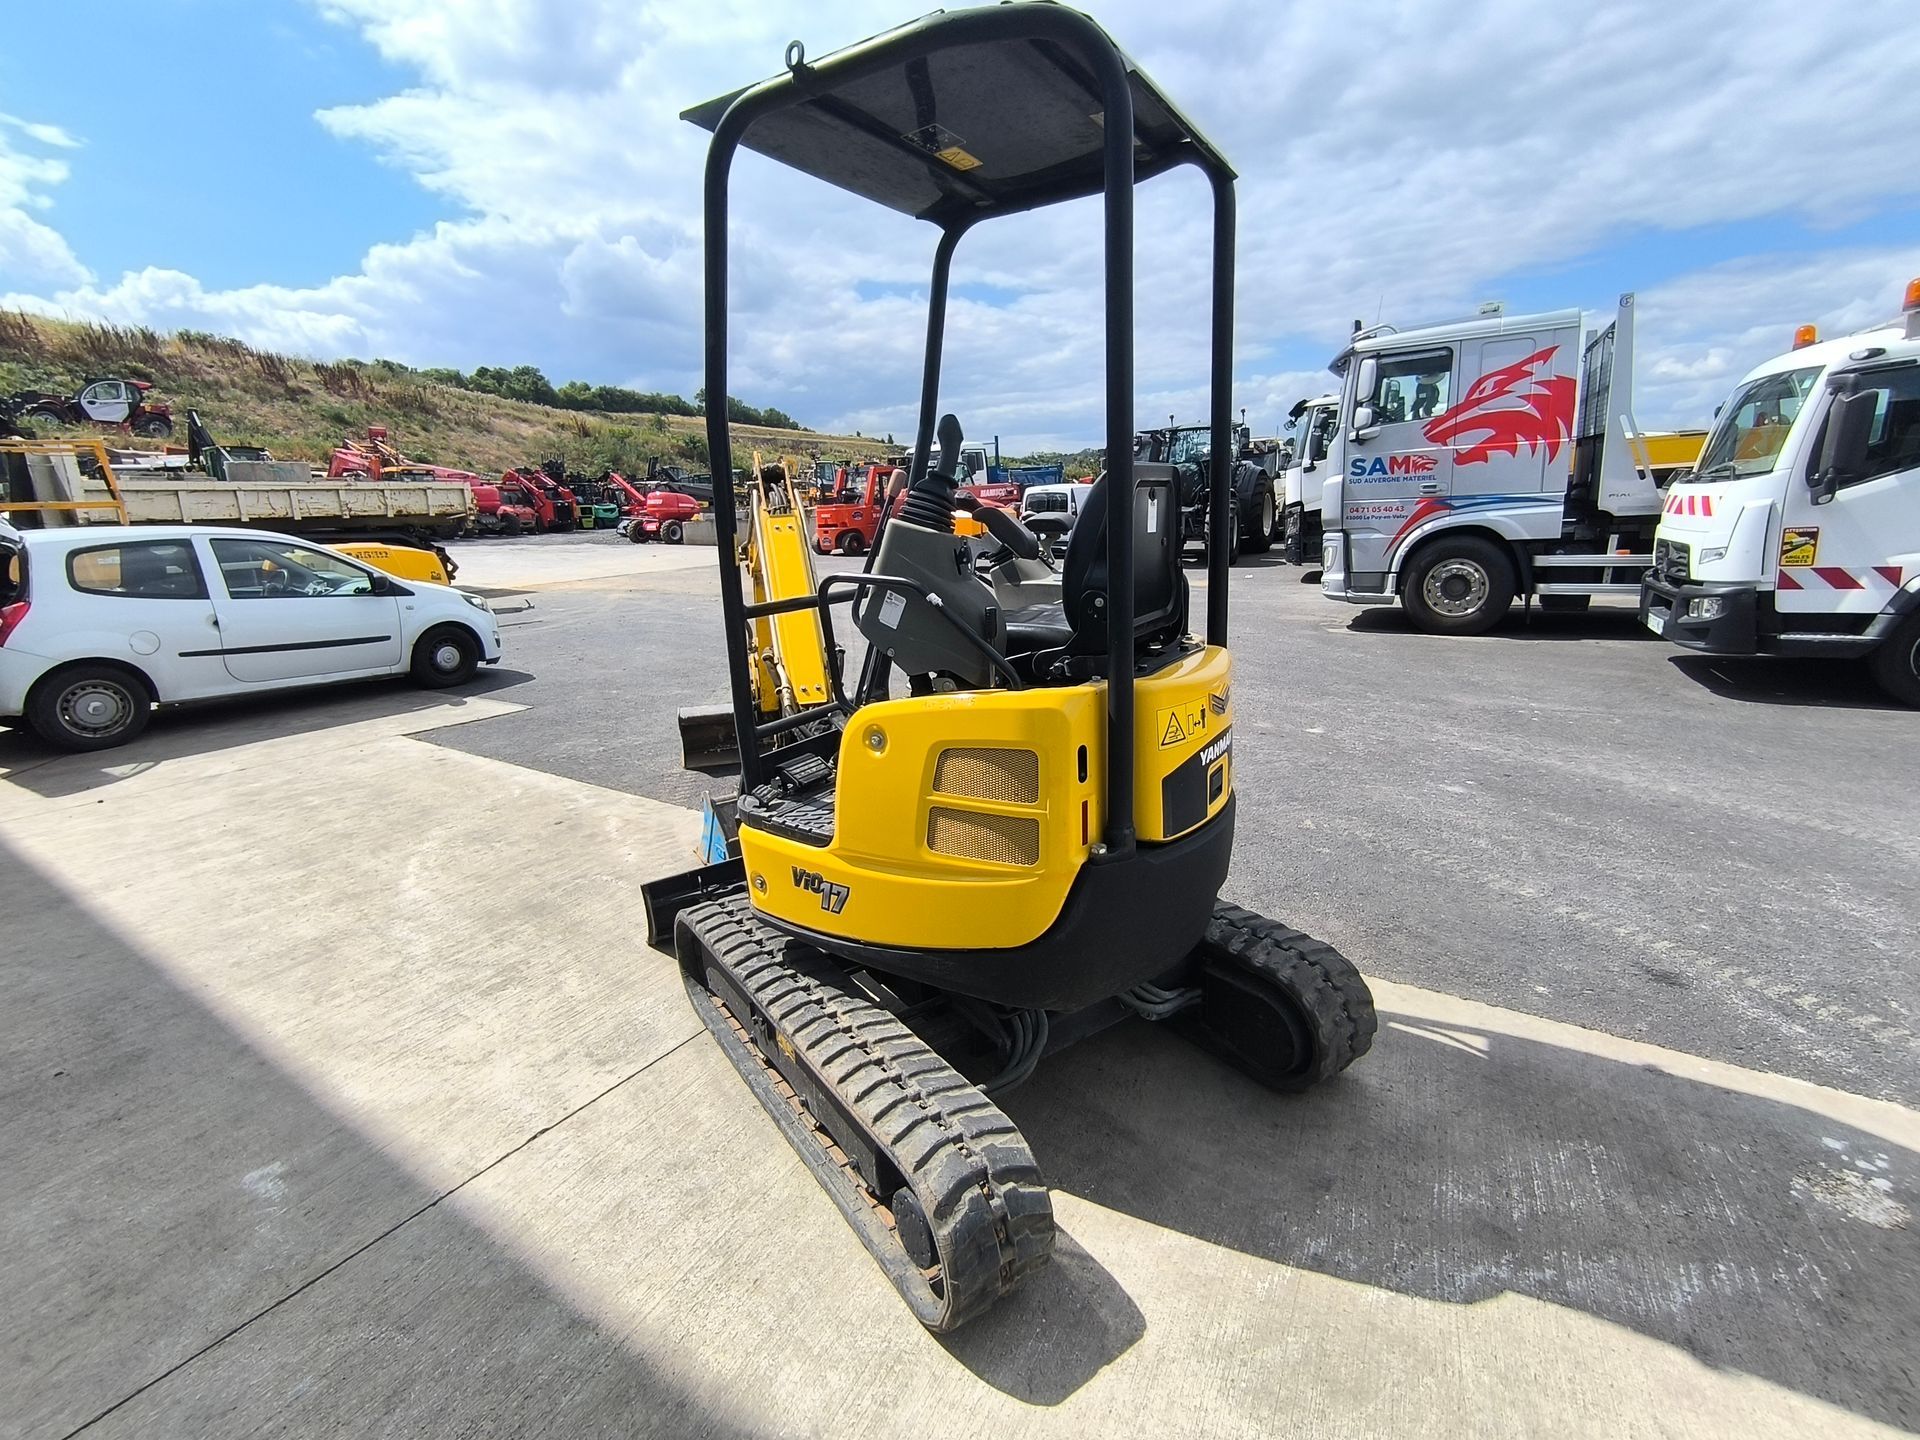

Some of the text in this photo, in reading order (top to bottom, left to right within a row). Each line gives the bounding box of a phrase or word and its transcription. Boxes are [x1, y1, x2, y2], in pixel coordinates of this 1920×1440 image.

[1350, 455, 1412, 477] SAM
[1364, 476, 1400, 484] AUVERGNE
[1402, 474, 1437, 482] MATERIEL
